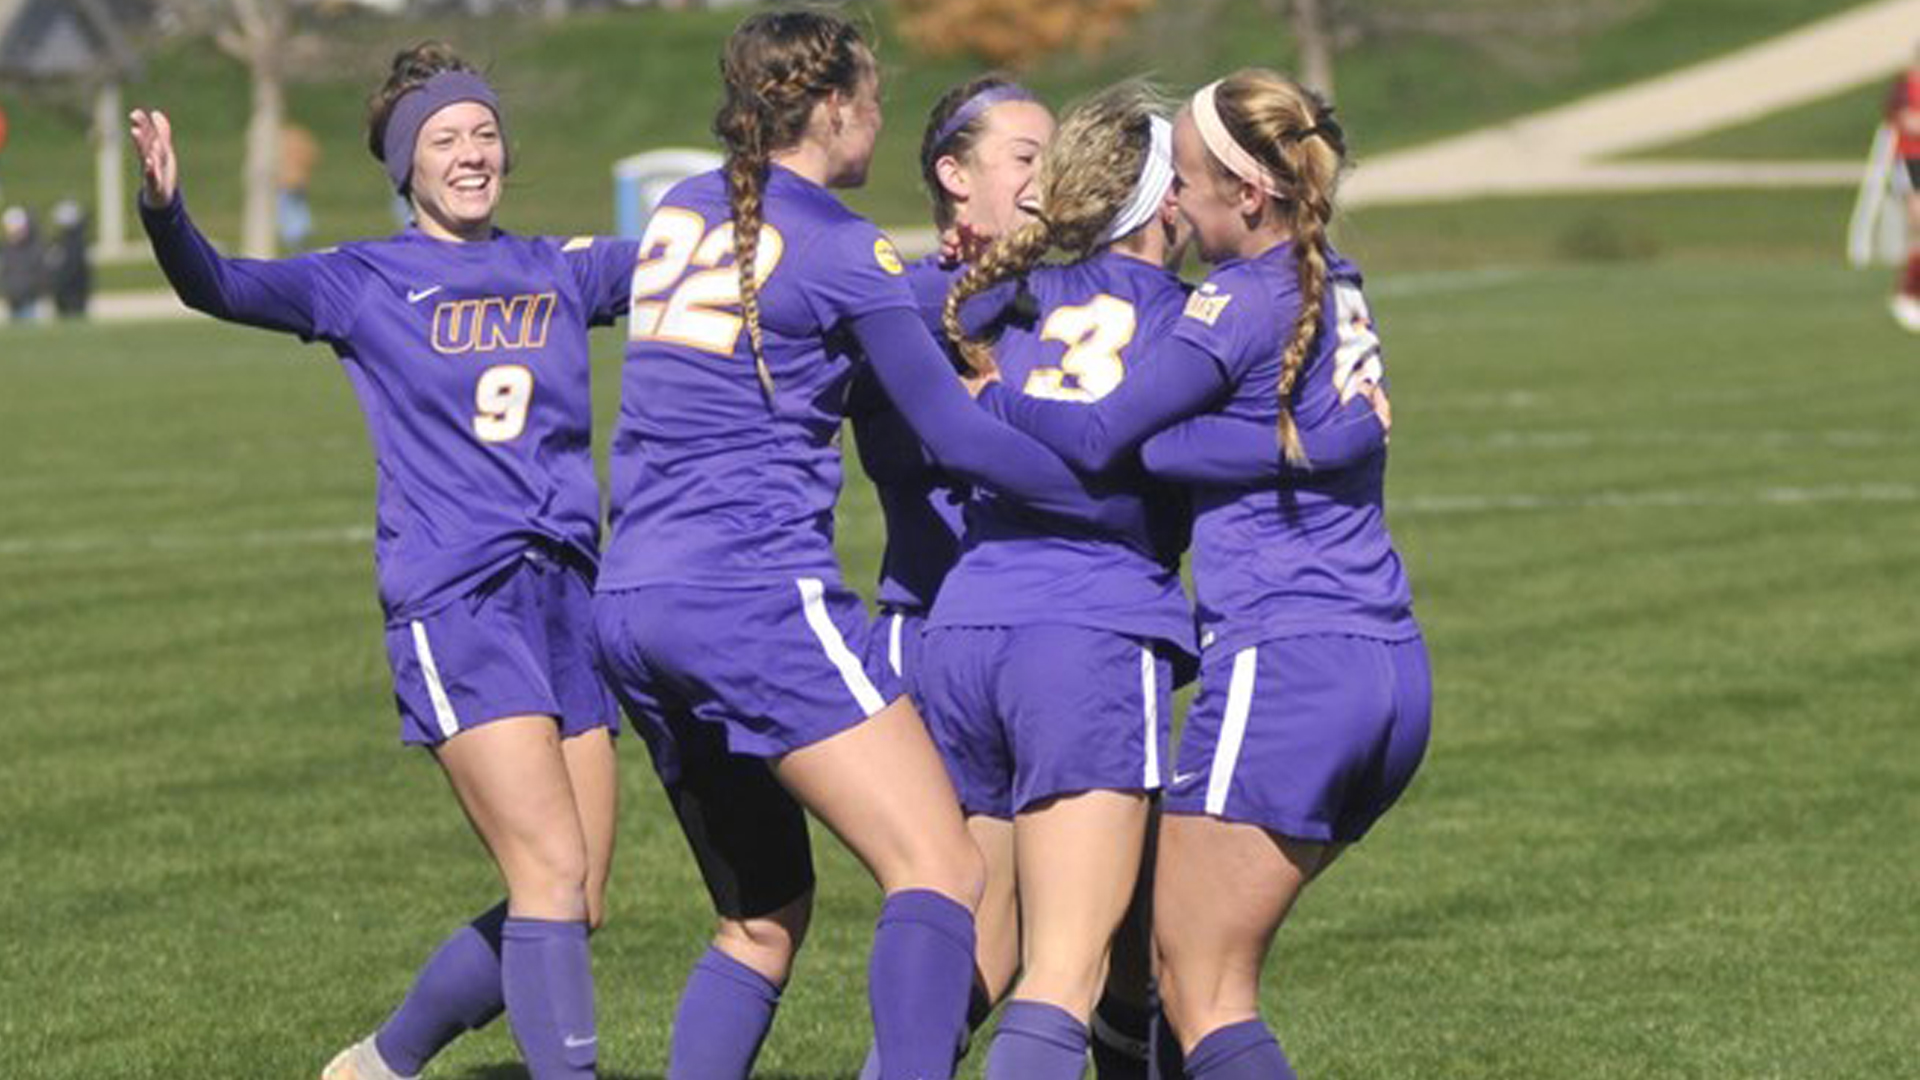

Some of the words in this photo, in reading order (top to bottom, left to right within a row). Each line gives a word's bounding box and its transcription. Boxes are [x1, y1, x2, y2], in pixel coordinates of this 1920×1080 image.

[431, 290, 557, 354] UNI
[629, 205, 784, 358] 22
[1022, 293, 1136, 404] 3
[473, 364, 535, 443] 9
